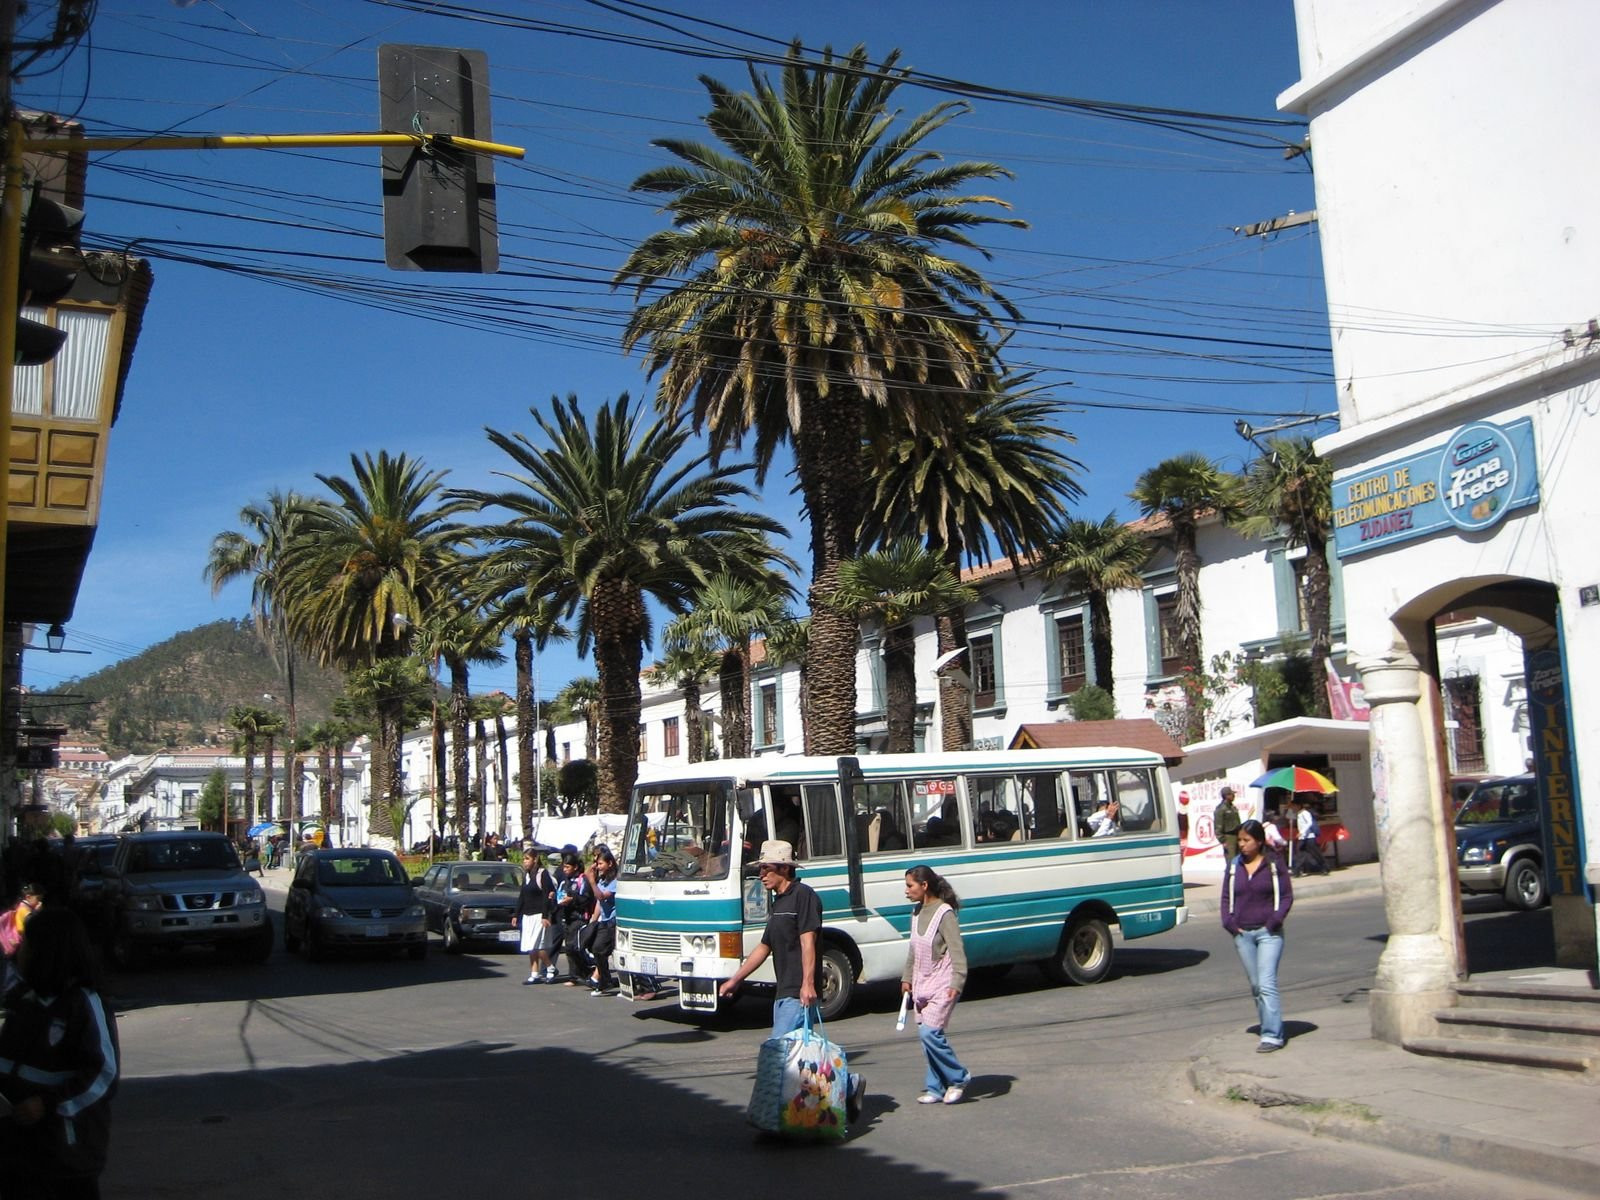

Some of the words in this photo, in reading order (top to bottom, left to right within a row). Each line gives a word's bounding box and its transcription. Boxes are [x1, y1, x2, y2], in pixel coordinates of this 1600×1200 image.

[1348, 474, 1389, 503] CENTRO
[1394, 467, 1410, 489] DE
[1451, 457, 1501, 488] Zona
[1544, 705, 1576, 894] INTERNET
[746, 880, 764, 907] 4
[682, 991, 715, 1004] NISSAN
